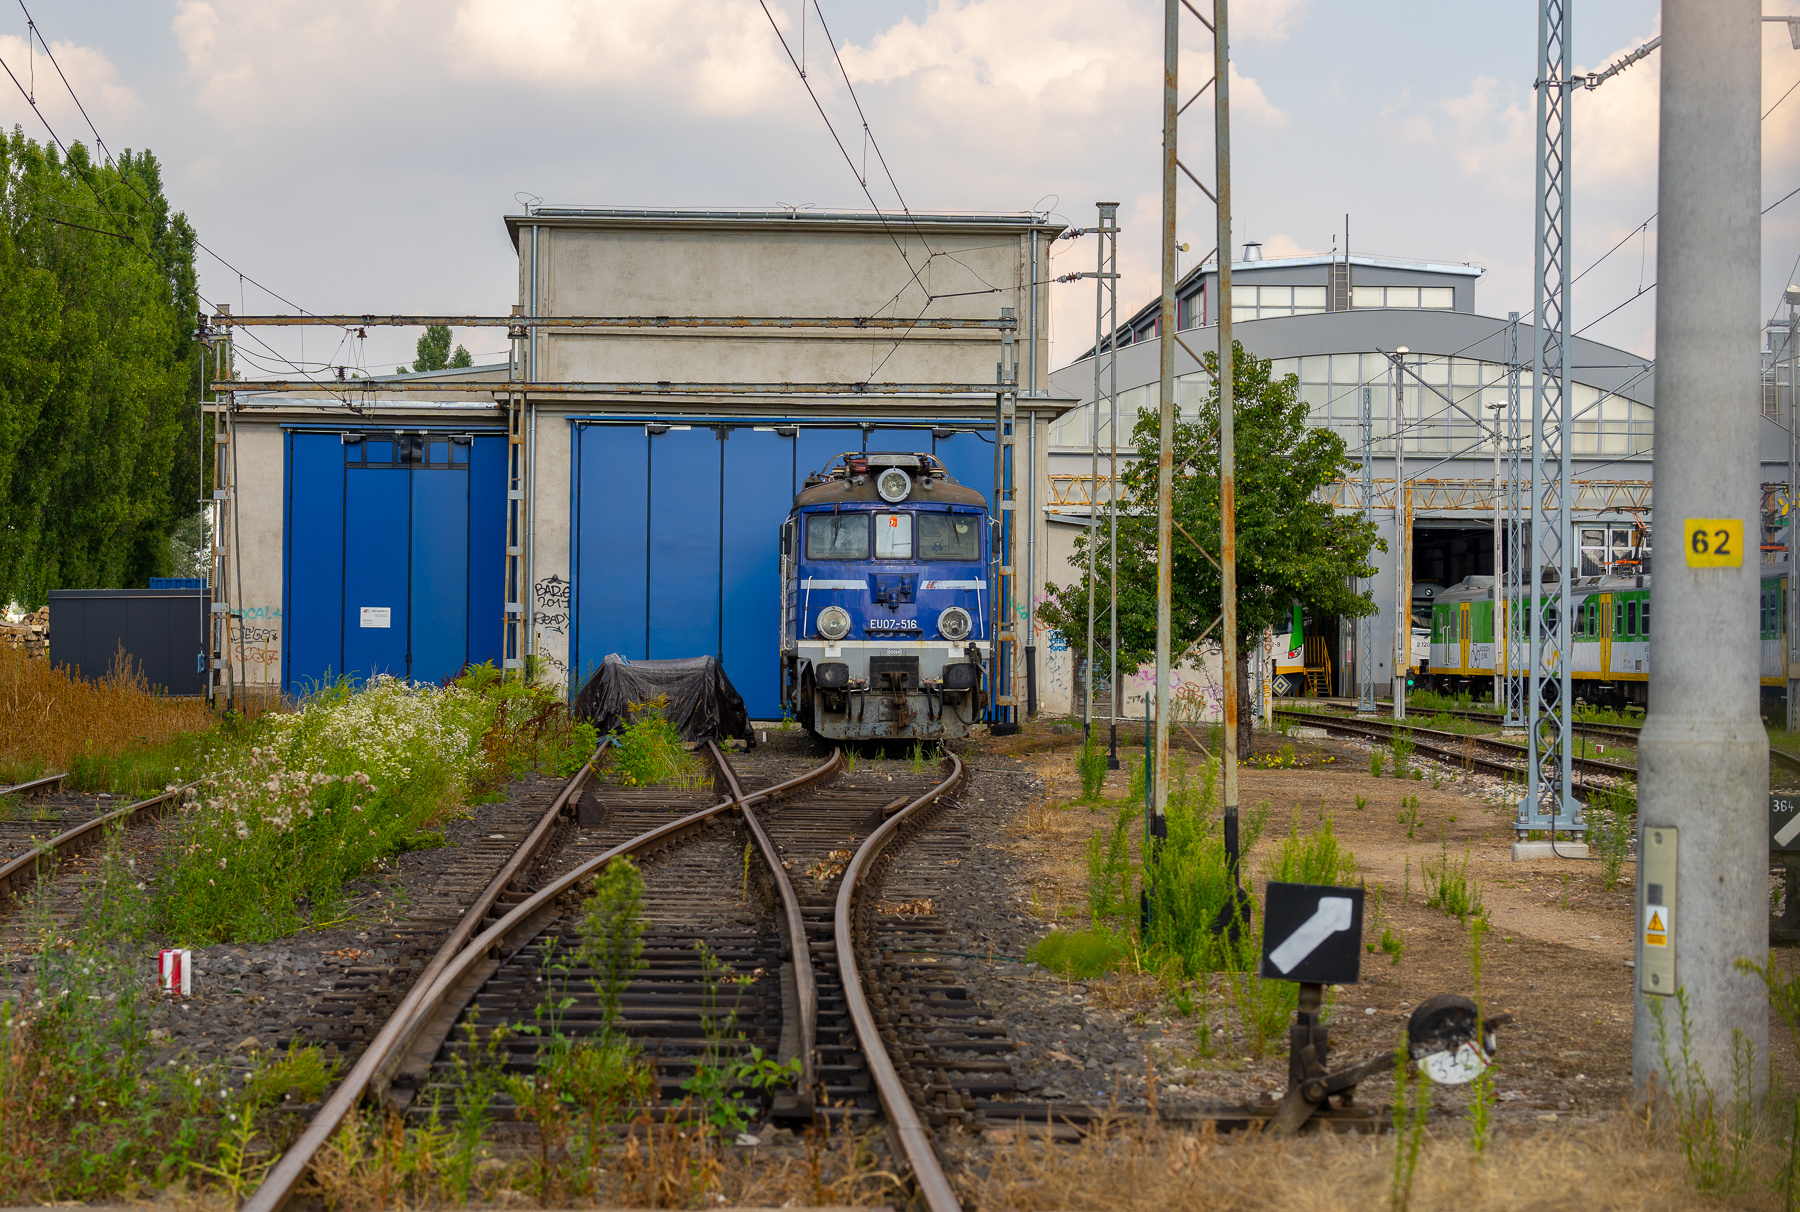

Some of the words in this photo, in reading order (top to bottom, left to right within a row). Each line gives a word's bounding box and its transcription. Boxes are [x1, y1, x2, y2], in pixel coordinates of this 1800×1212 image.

[1692, 530, 1731, 555] 62
[870, 619, 917, 629] EU07-516
[1772, 799, 1795, 813] 364
